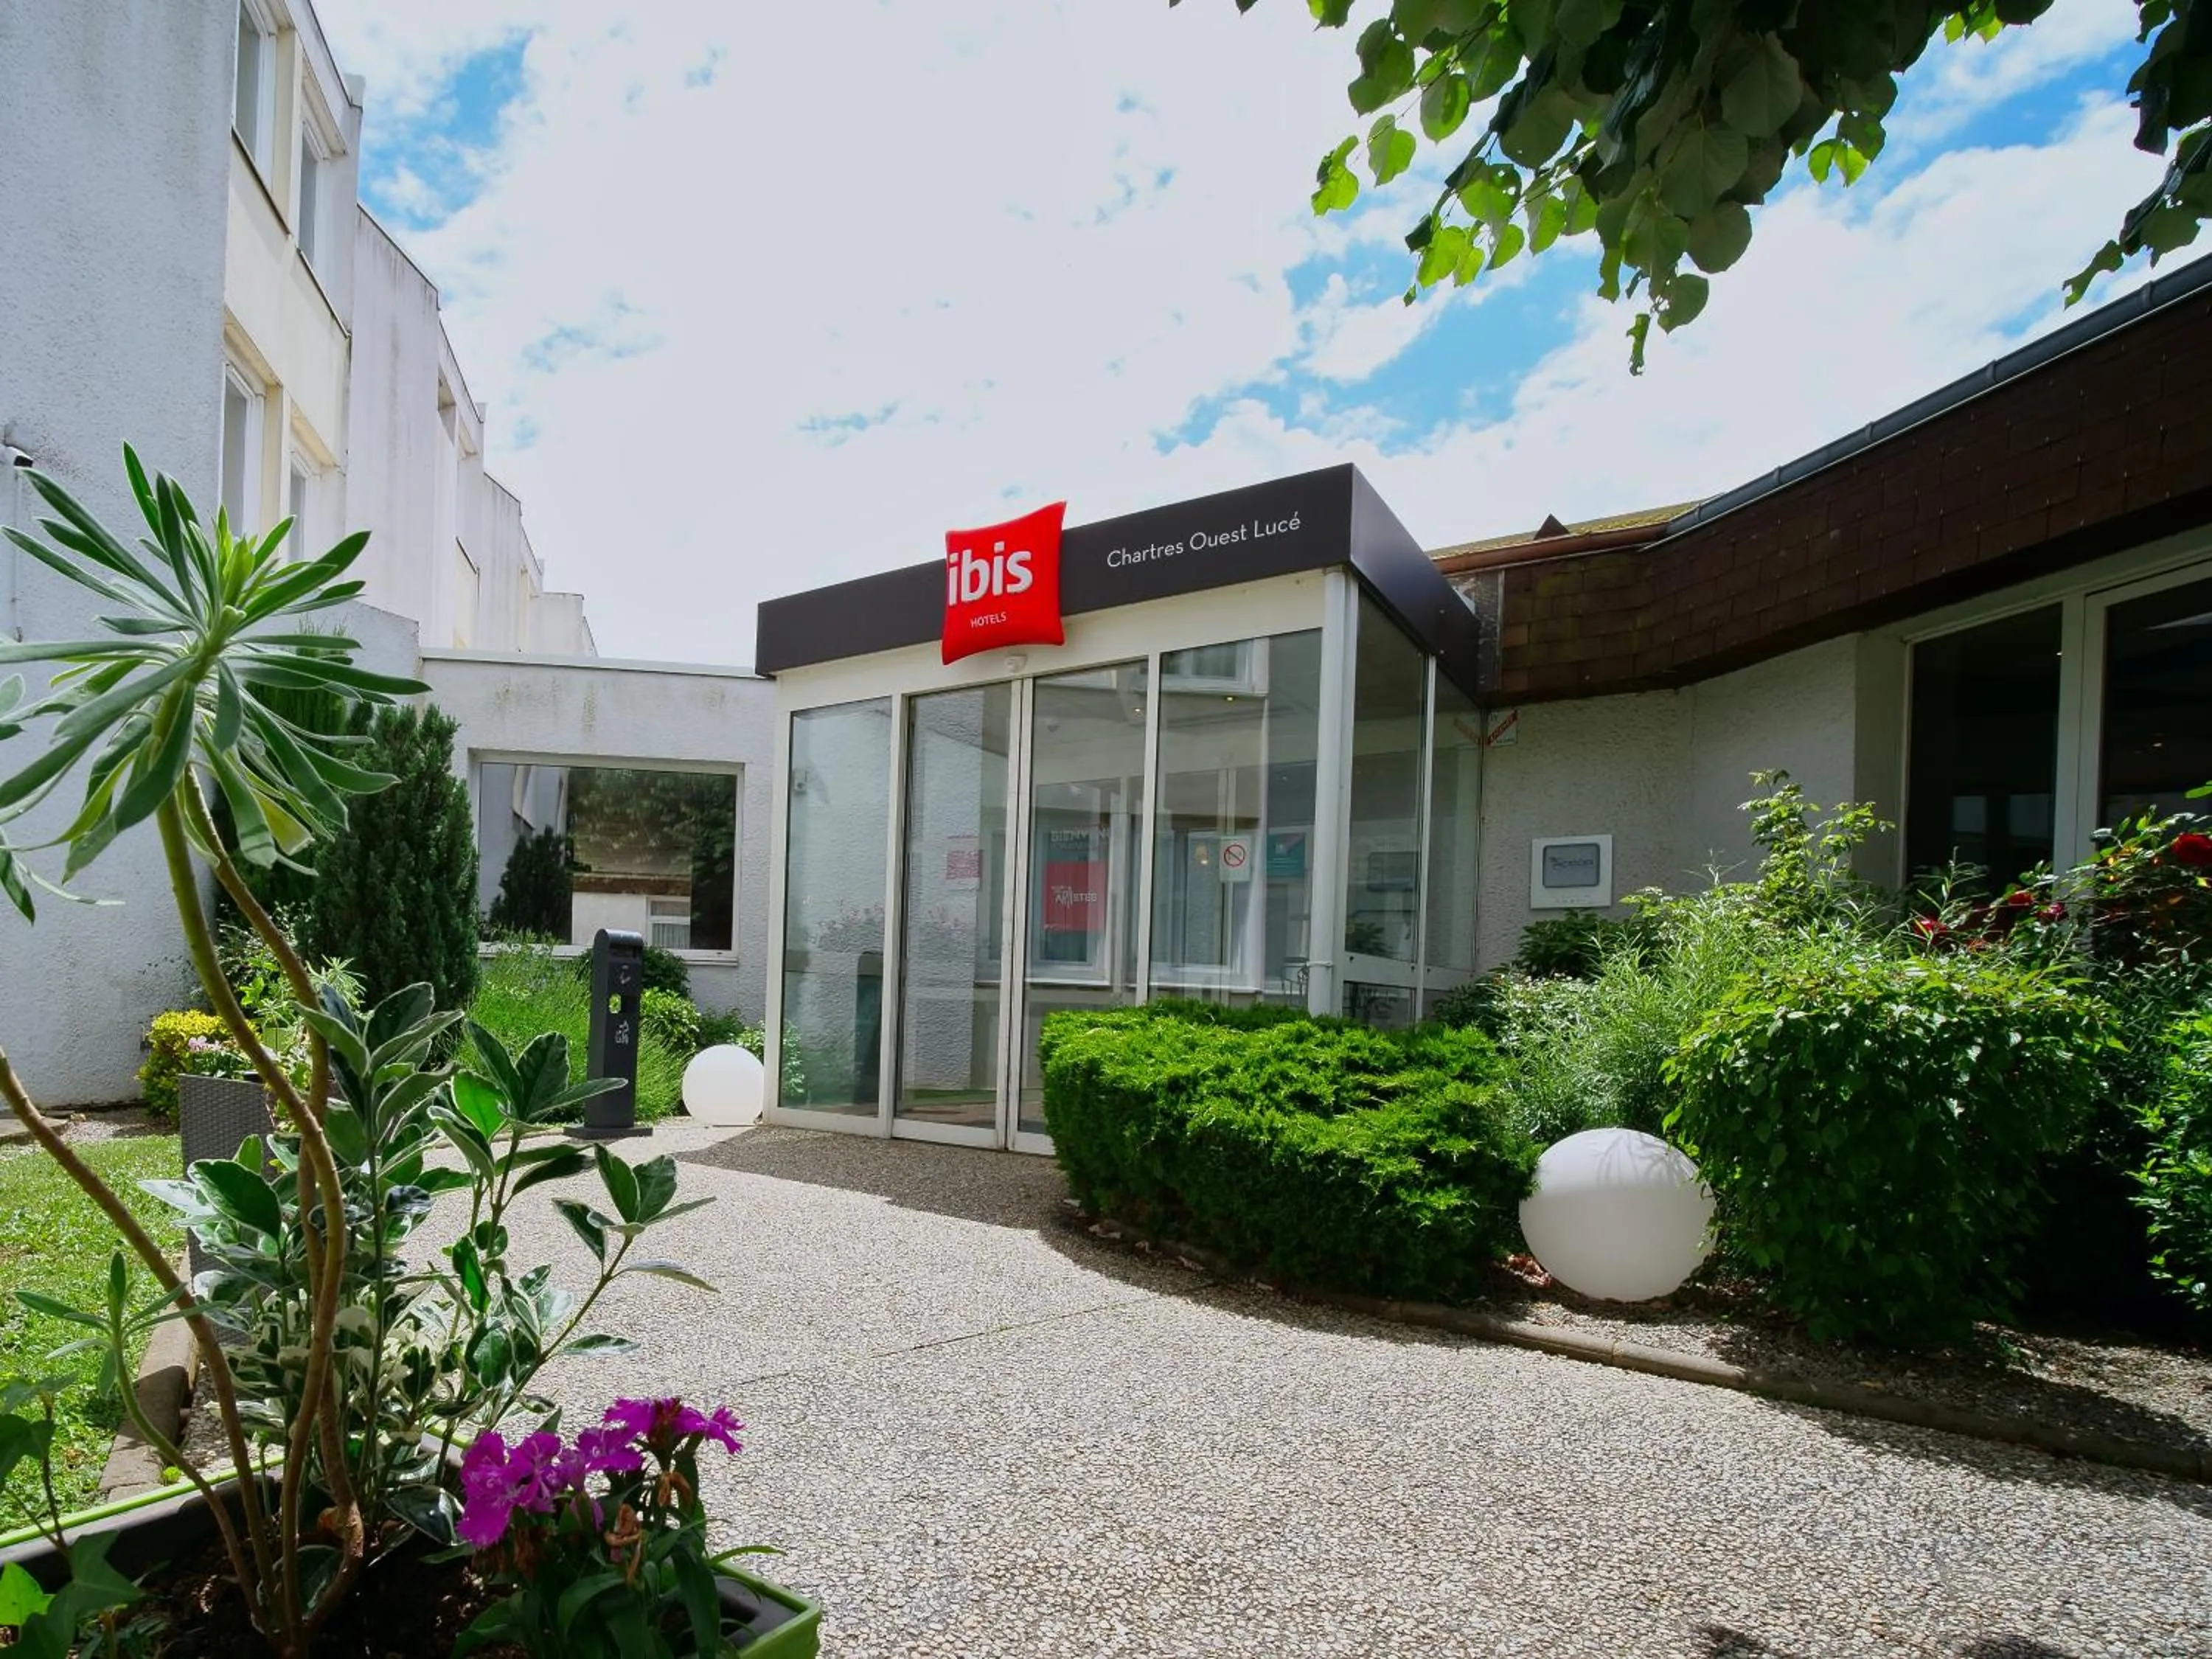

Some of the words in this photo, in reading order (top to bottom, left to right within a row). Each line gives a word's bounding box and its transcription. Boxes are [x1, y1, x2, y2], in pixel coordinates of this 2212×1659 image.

[1107, 543, 1184, 568] Chartres
[1189, 524, 1248, 551] Ouest
[1254, 511, 1301, 538] Lucé
[948, 540, 1033, 606] ibis
[970, 611, 1007, 628] HOTELS
